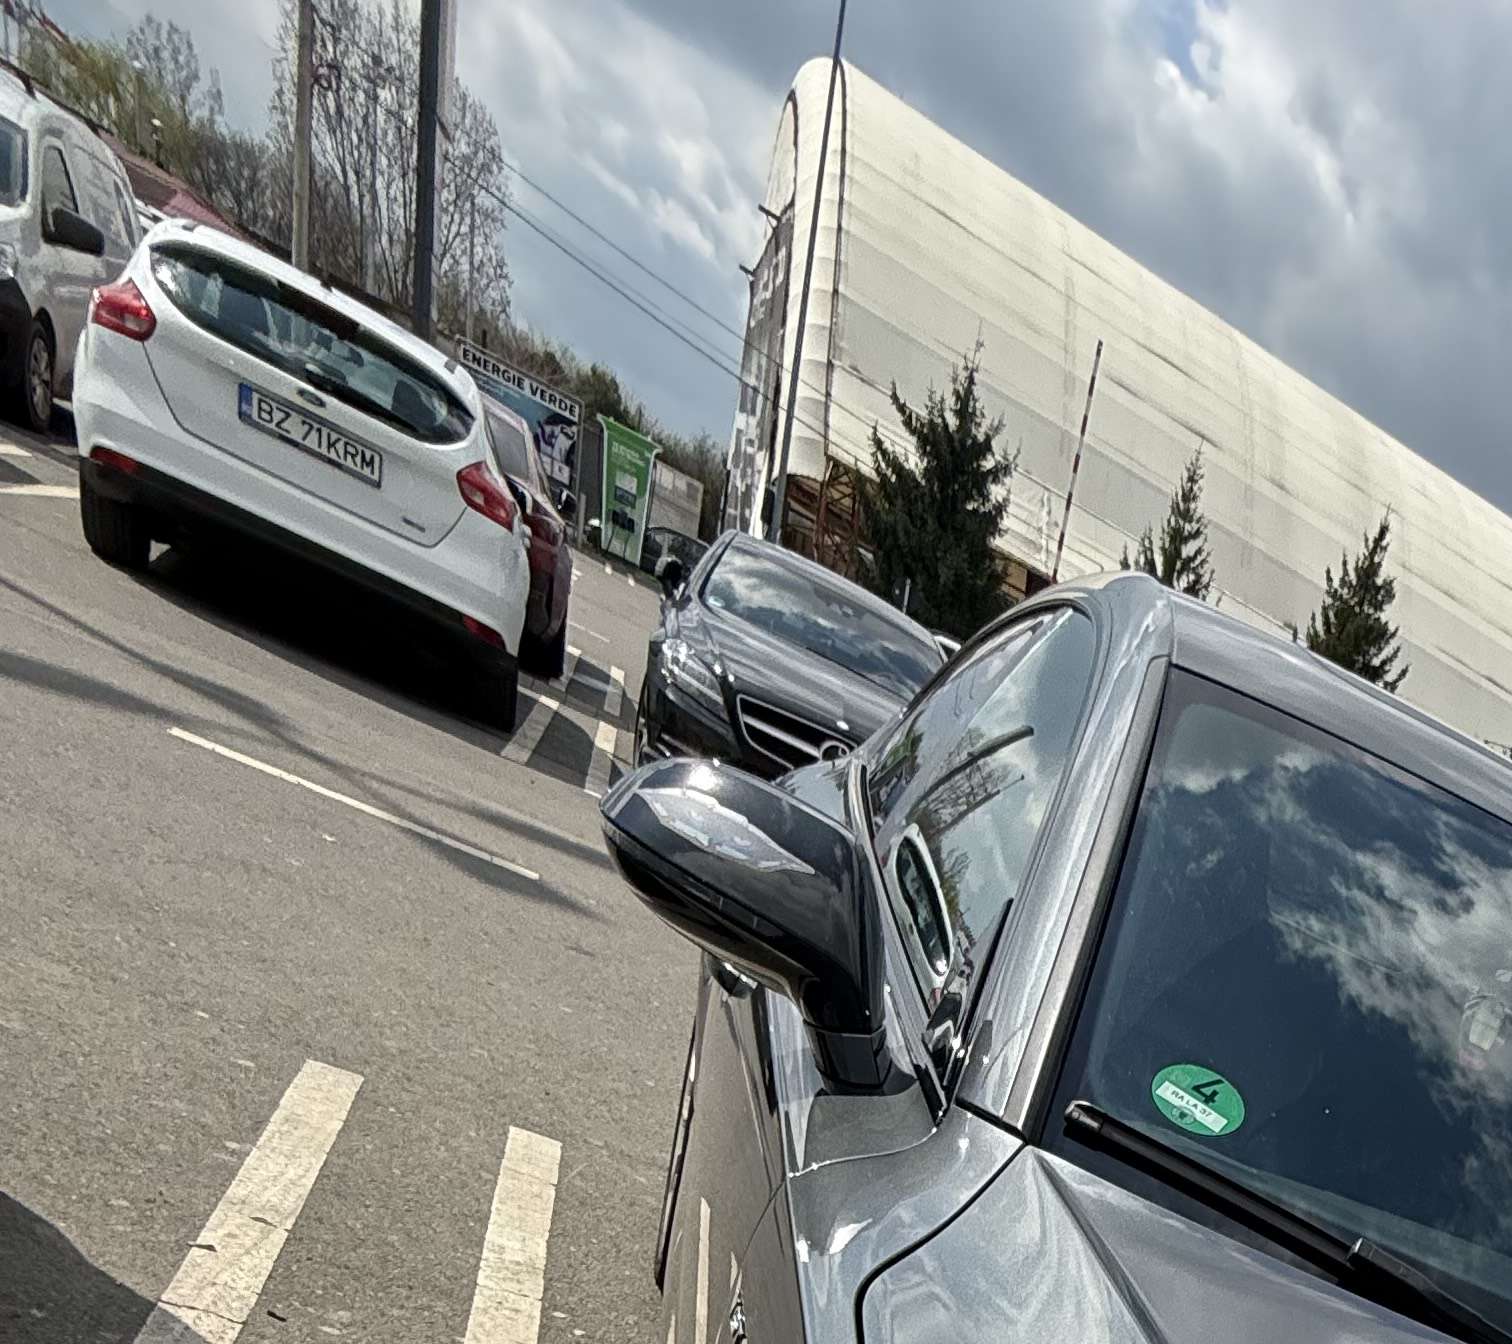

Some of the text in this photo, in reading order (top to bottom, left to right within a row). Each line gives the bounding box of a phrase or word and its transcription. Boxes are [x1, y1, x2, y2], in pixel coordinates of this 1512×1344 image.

[462, 347, 577, 418] ENERGIE VERDE
[257, 397, 376, 476] BZ 71KRM
[1192, 1079, 1225, 1105] 4
